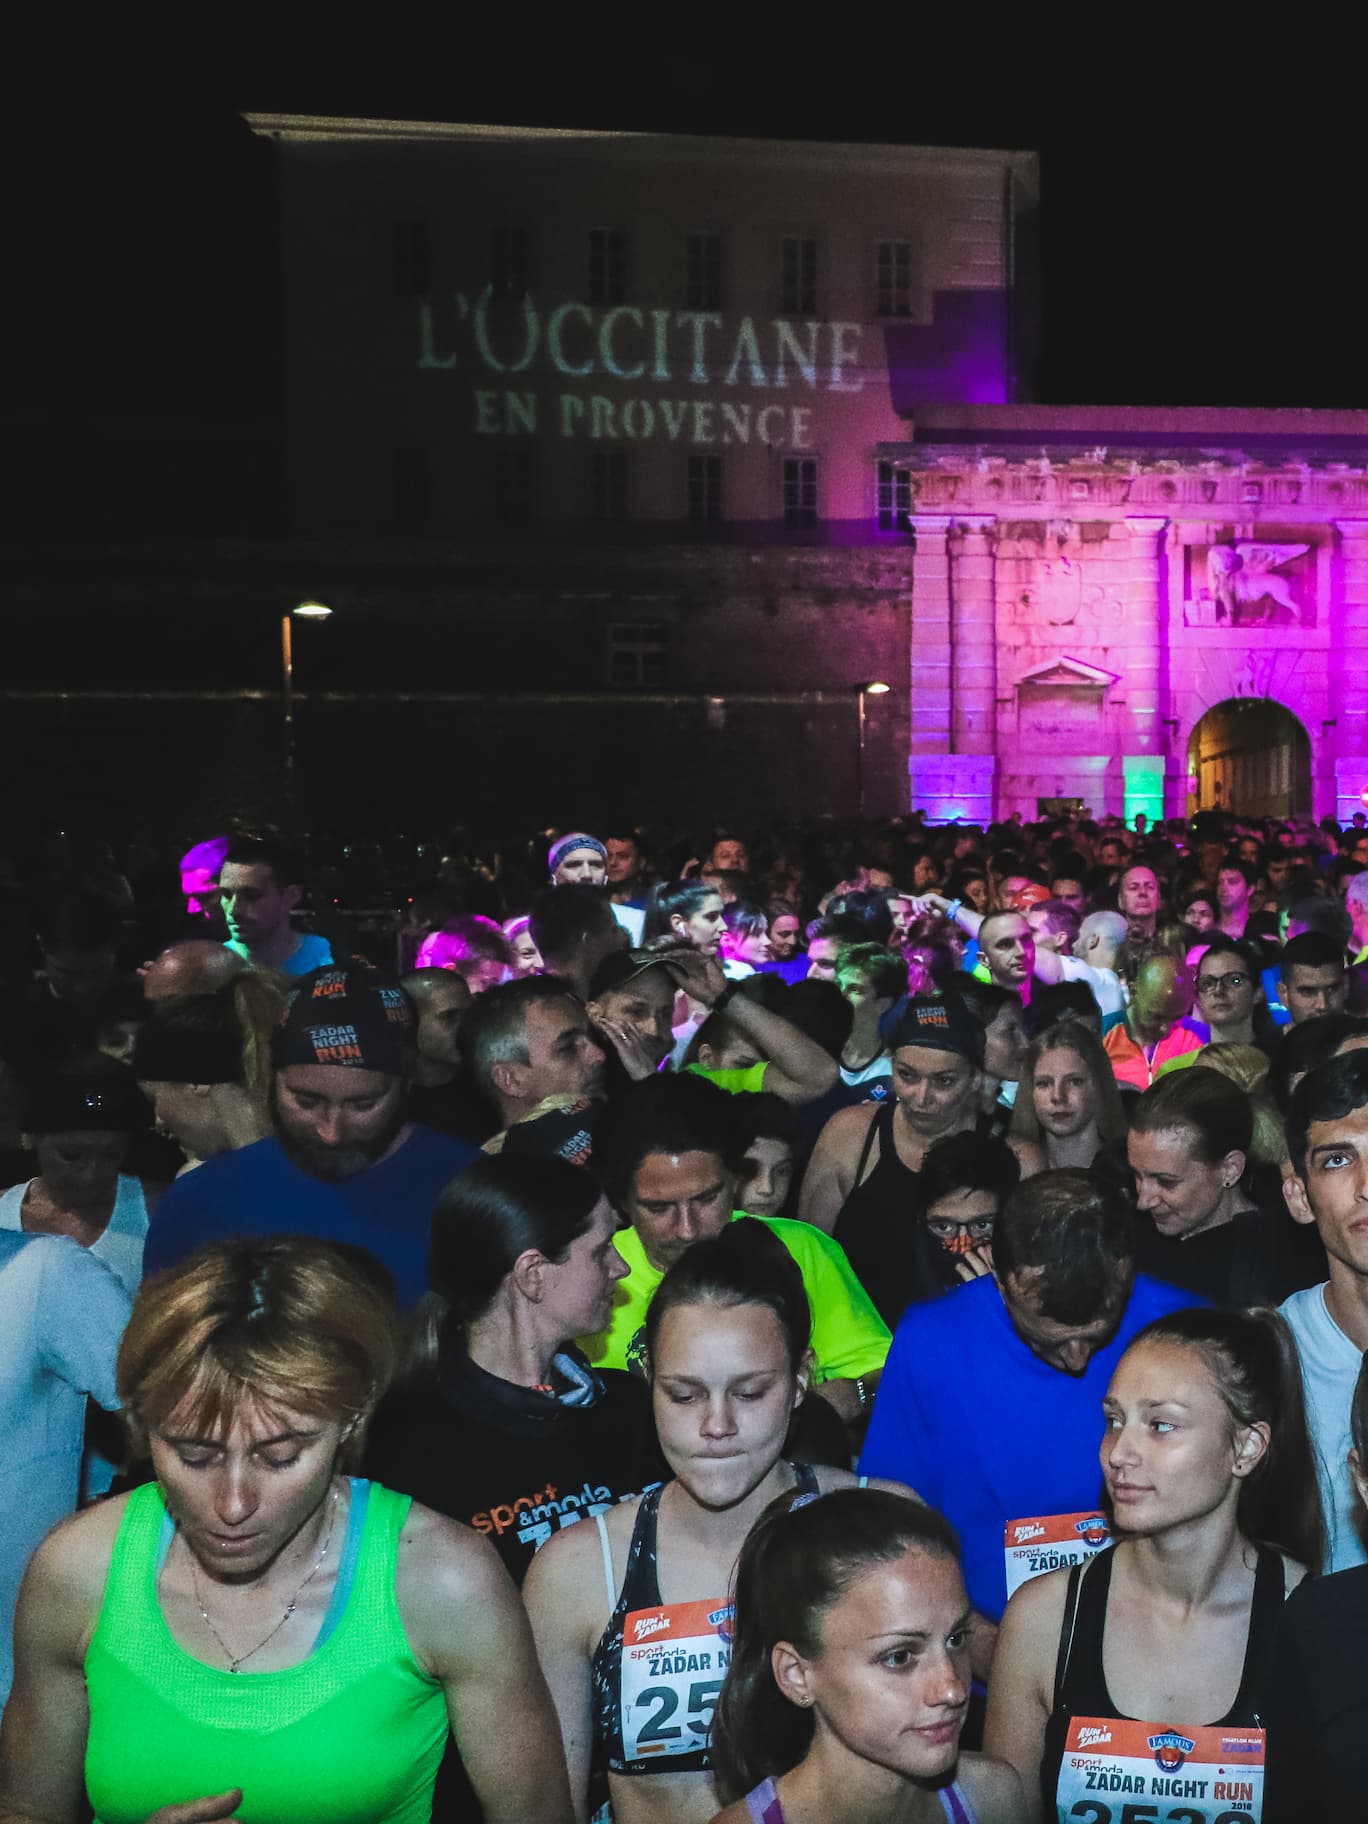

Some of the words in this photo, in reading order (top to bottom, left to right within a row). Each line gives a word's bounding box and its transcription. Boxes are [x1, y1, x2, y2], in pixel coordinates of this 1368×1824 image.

[416, 281, 864, 392] L'OCCITANE
[474, 390, 537, 434] EN
[559, 395, 813, 449] PROVENCE
[310, 1025, 355, 1039] ZADAR
[313, 1034, 358, 1048] NIGHT
[316, 1045, 362, 1063] RUN
[472, 1484, 558, 1535] sport
[520, 1483, 611, 1527] &moda
[1030, 1554, 1078, 1572] ZADAR
[635, 1616, 659, 1633] RUN
[637, 1618, 671, 1642] ZADAR
[649, 1652, 711, 1677] ZADAR
[1078, 1727, 1102, 1740] RUN
[1078, 1732, 1112, 1749] ZADAR
[1151, 1737, 1191, 1750] FAMOUS
[1070, 1758, 1102, 1769] sport
[1085, 1772, 1146, 1795] ZADAR
[1152, 1777, 1209, 1799] NIGHT
[1213, 1781, 1254, 1801] RUN
[1231, 1802, 1253, 1811] 2018
